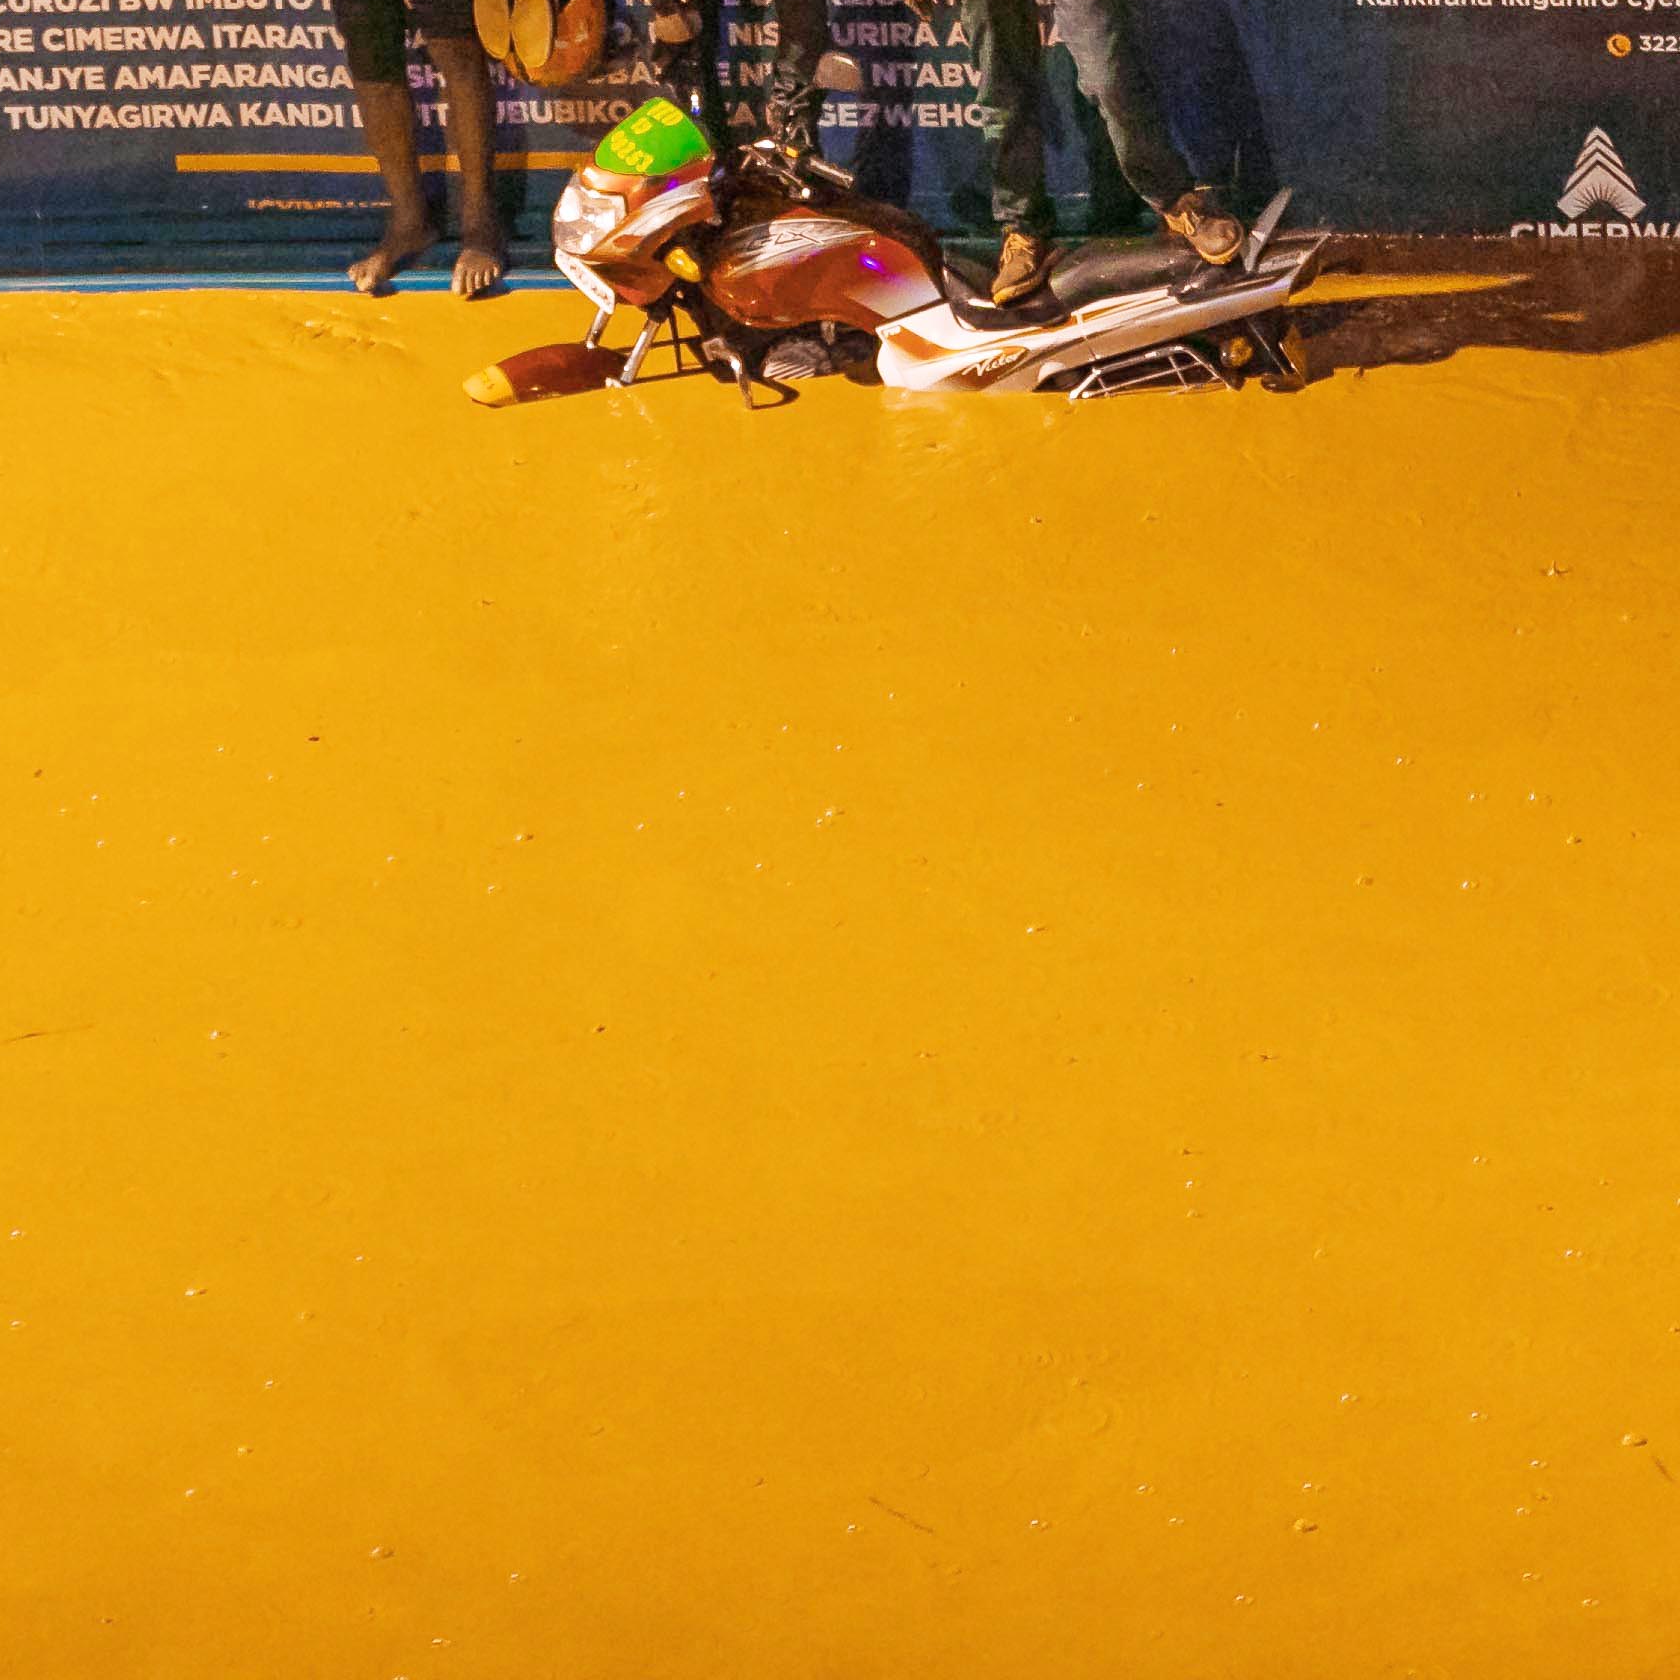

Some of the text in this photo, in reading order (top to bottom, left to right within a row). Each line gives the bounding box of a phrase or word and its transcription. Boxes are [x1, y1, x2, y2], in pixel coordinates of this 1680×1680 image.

[42, 25, 205, 52] CIMERWA
[114, 63, 355, 90] AMAFARANGA
[4, 104, 233, 130] TUNYAGIRWA
[239, 102, 344, 128] KANDI
